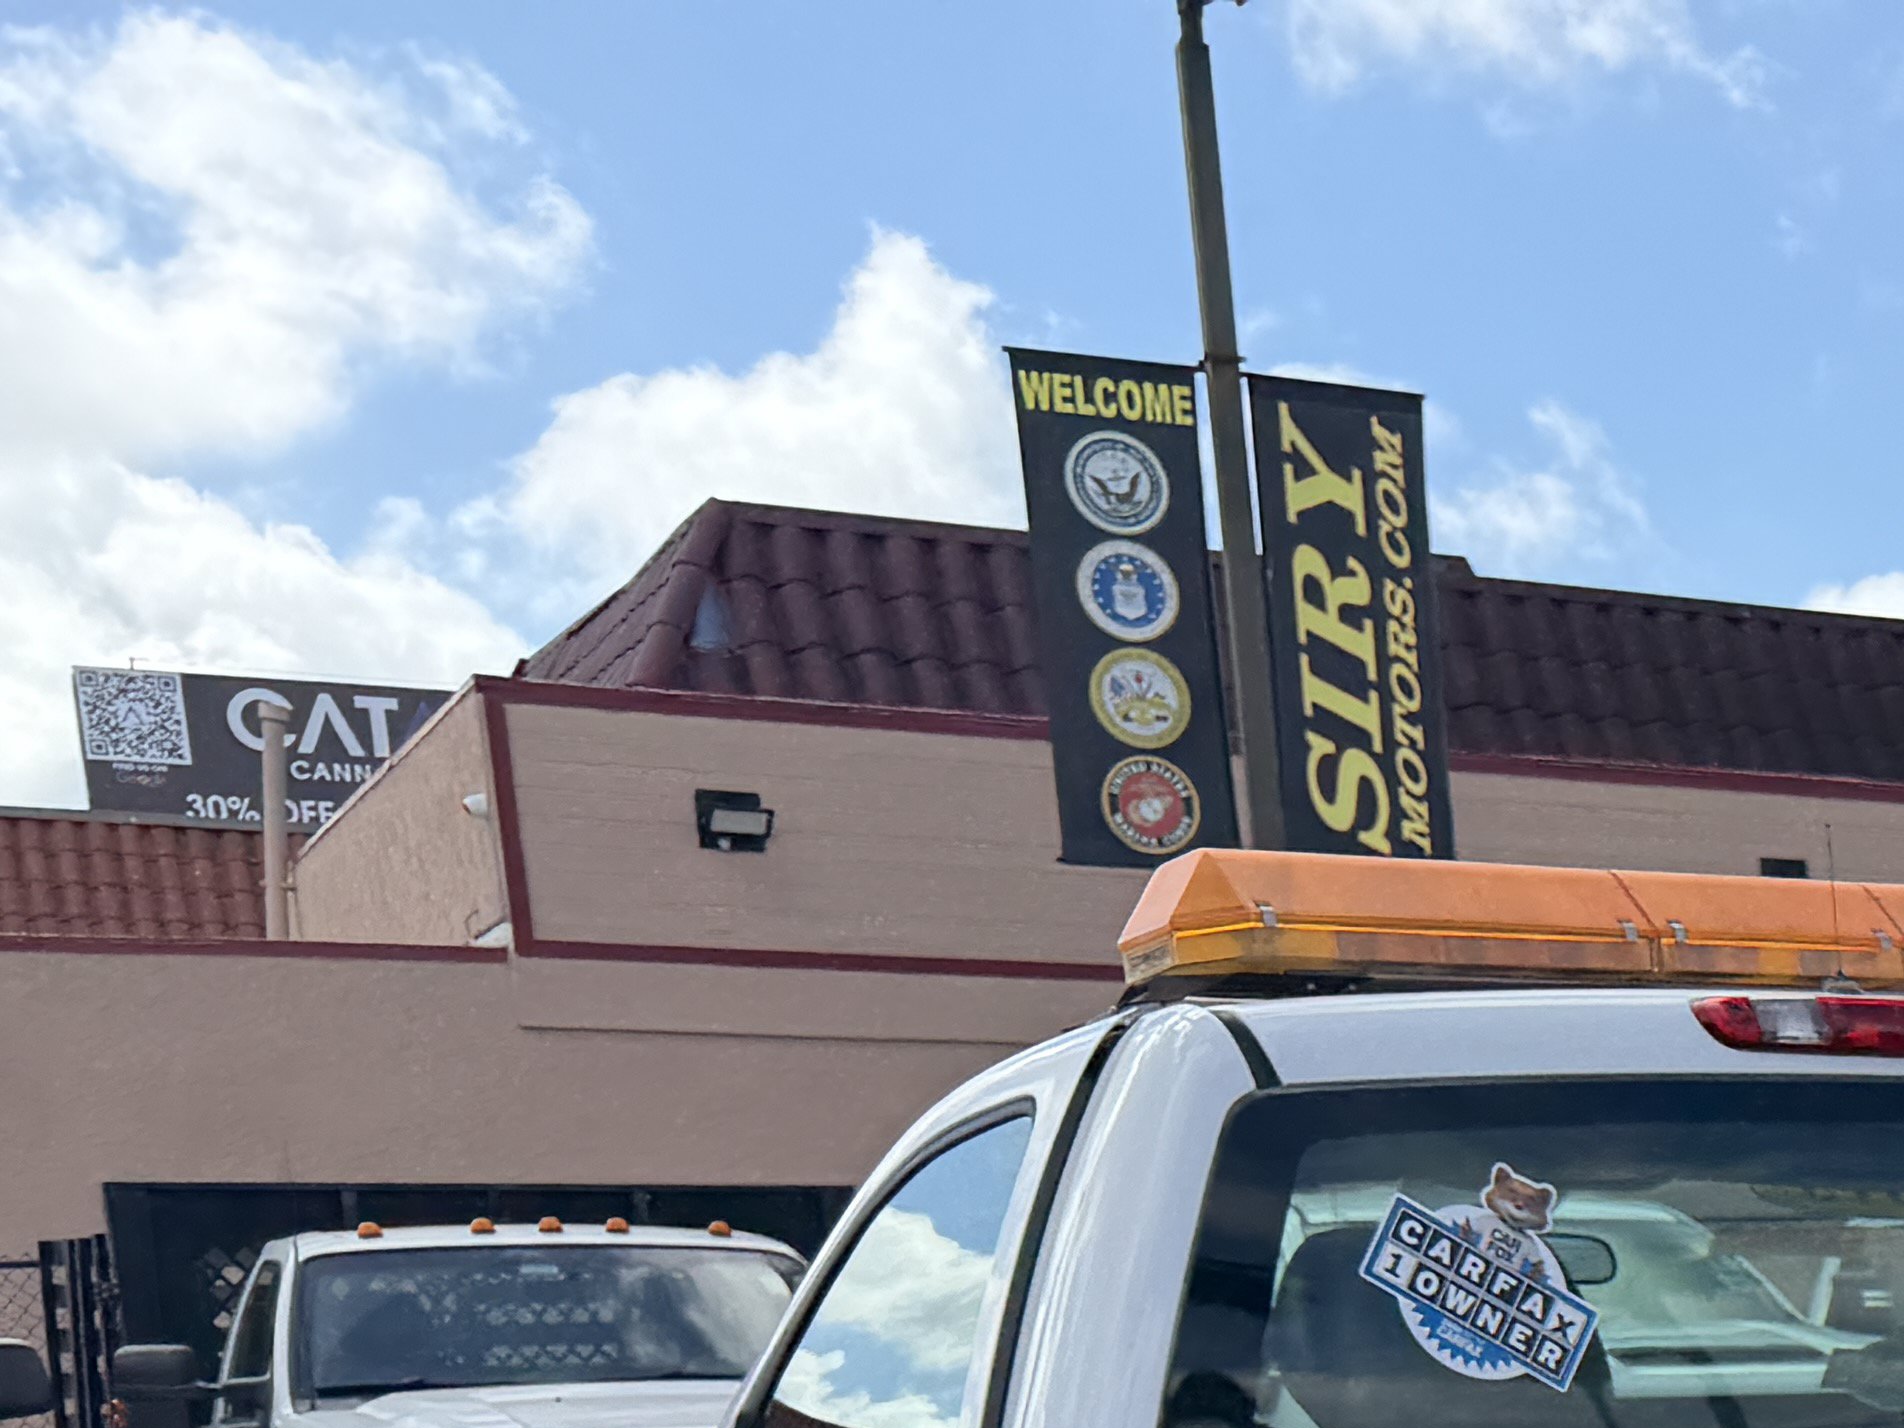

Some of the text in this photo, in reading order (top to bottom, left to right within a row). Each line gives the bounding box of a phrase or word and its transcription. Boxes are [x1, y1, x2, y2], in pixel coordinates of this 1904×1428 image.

[1018, 369, 1194, 427] WELCOME
[1277, 401, 1392, 857] SIRY
[1369, 415, 1432, 856] MOTORS.COM
[185, 793, 261, 821] 30%
[1384, 1252, 1401, 1279] 1
[1415, 1270, 1563, 1371] OWNER
[1399, 1218, 1577, 1346] CARFAX
